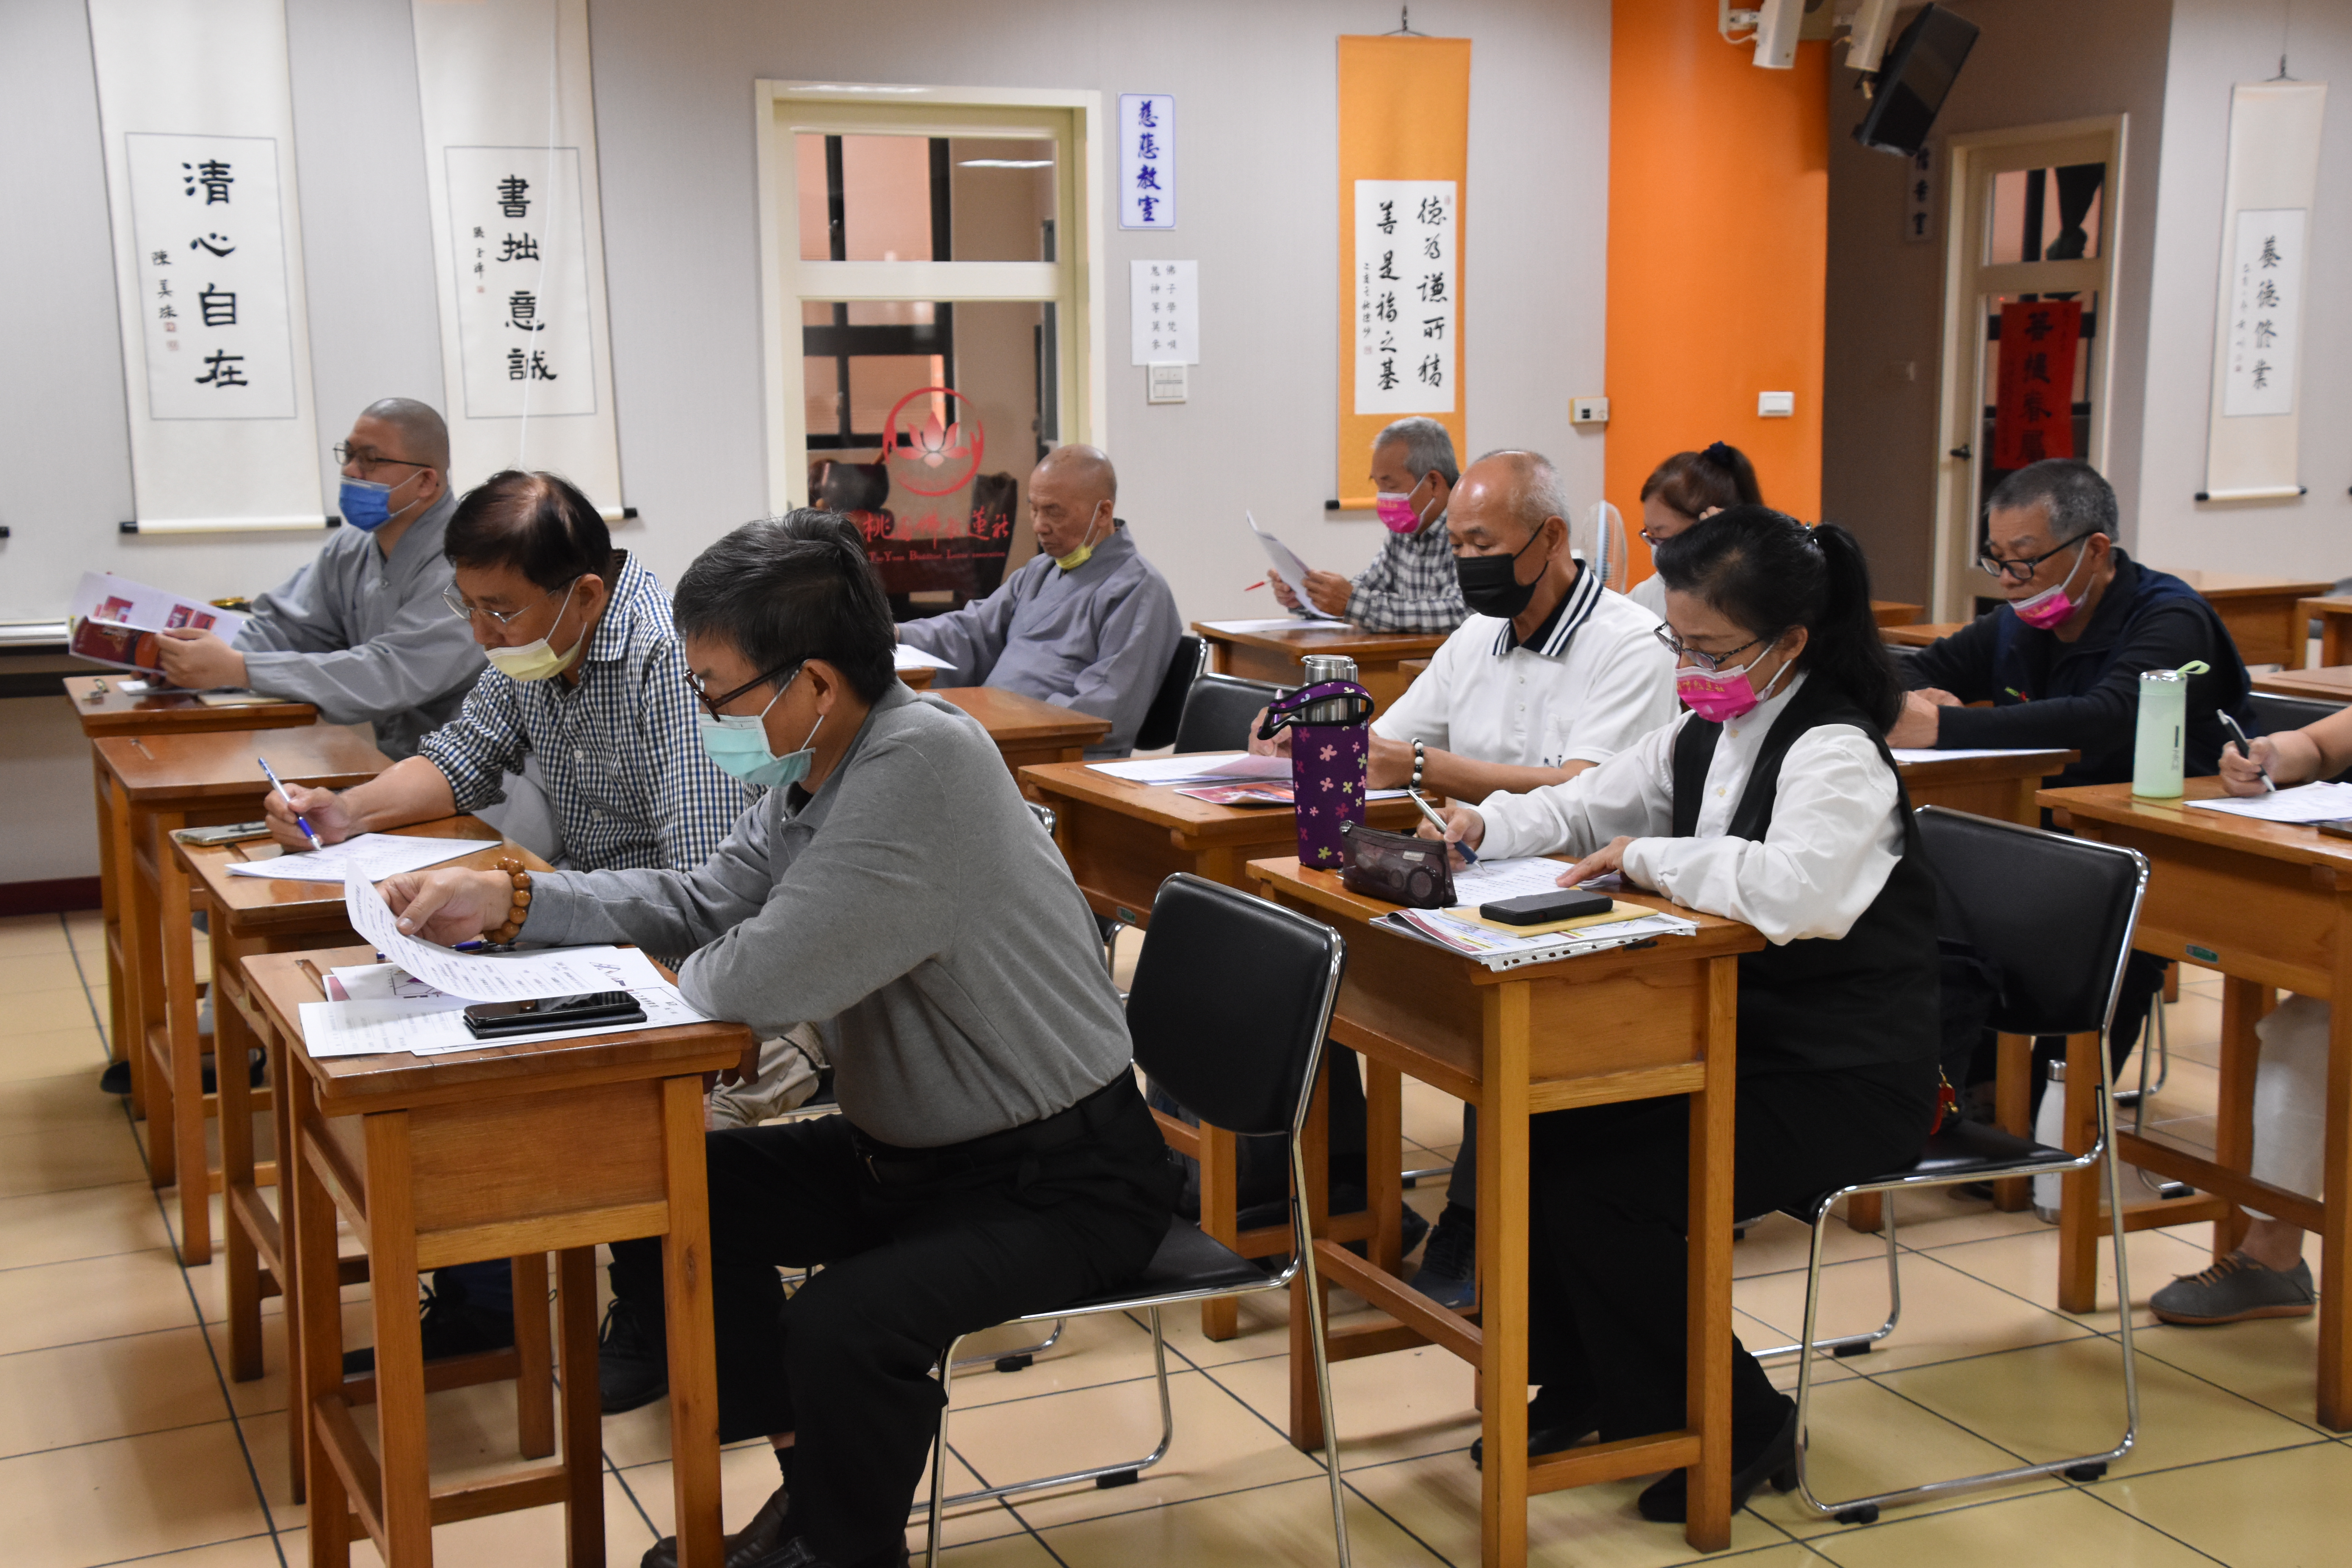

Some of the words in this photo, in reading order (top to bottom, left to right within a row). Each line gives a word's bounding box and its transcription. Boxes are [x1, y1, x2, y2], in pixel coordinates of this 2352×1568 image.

[1136, 100, 1161, 221] 慈悲教室
[181, 159, 249, 388] 清心自在
[496, 174, 557, 380] 書拙意誠
[1376, 200, 1401, 390] 善是福之基
[2252, 235, 2282, 389] 養德修業
